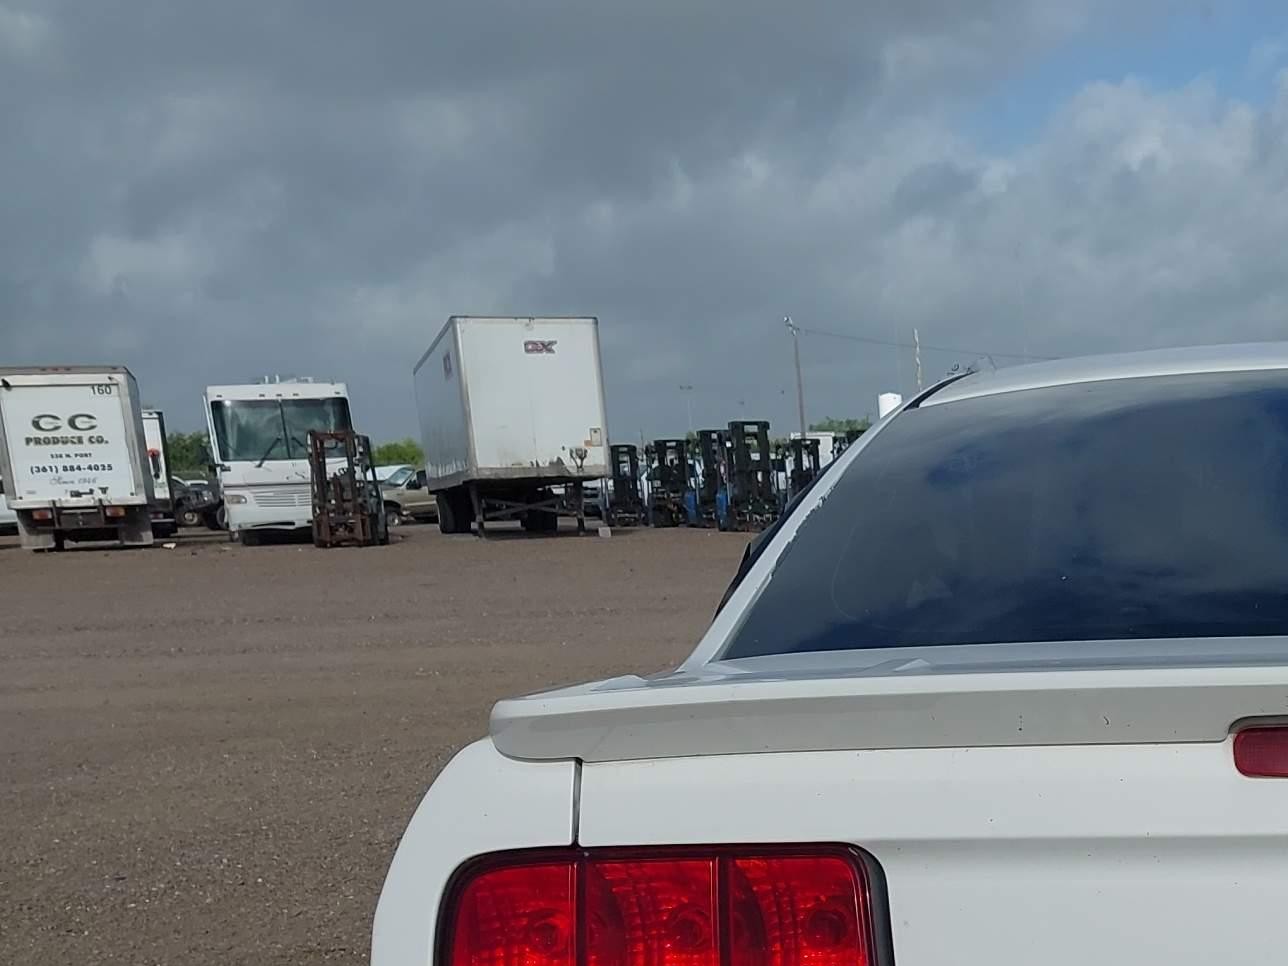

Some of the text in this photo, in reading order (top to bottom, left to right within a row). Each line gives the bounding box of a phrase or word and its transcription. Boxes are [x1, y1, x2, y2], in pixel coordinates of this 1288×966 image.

[91, 385, 112, 395] 160
[25, 435, 109, 446] PRODUCE CO.
[30, 465, 58, 475] (361)
